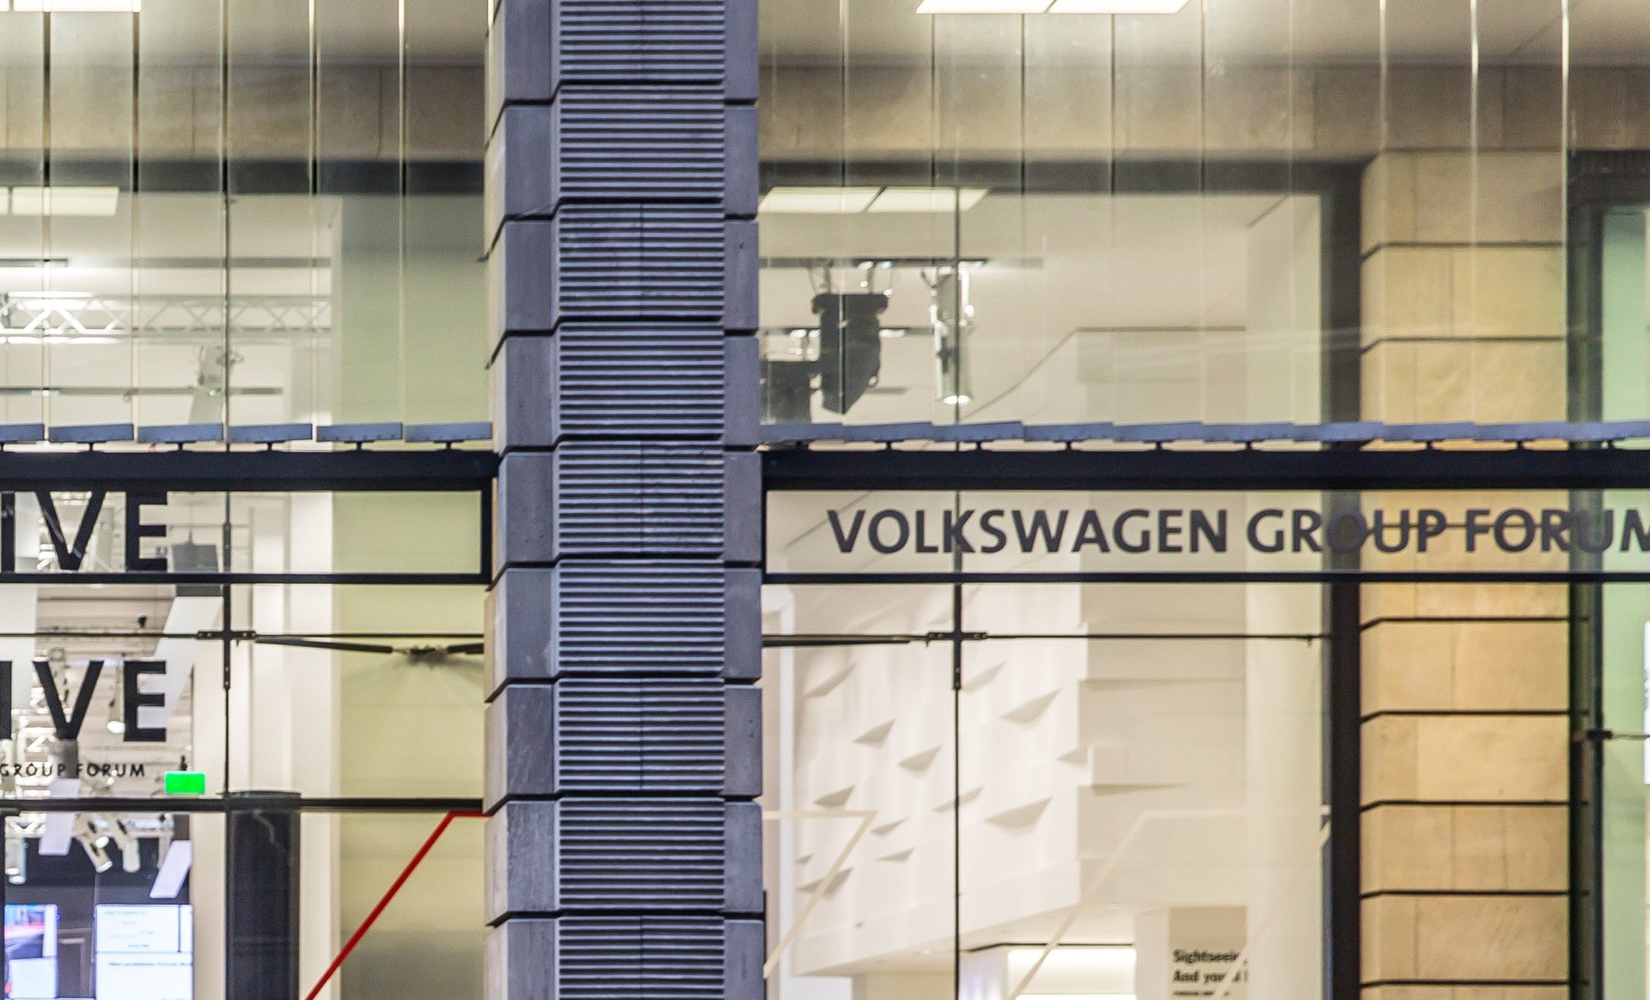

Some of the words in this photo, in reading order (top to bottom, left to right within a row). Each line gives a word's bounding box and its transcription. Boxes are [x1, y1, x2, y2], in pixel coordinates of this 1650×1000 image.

[827, 508, 1229, 553] VOLKSWAGEN
[1246, 508, 1448, 553] GROUP
[0, 763, 67, 777] GROUP
[76, 763, 146, 777] FORUM
